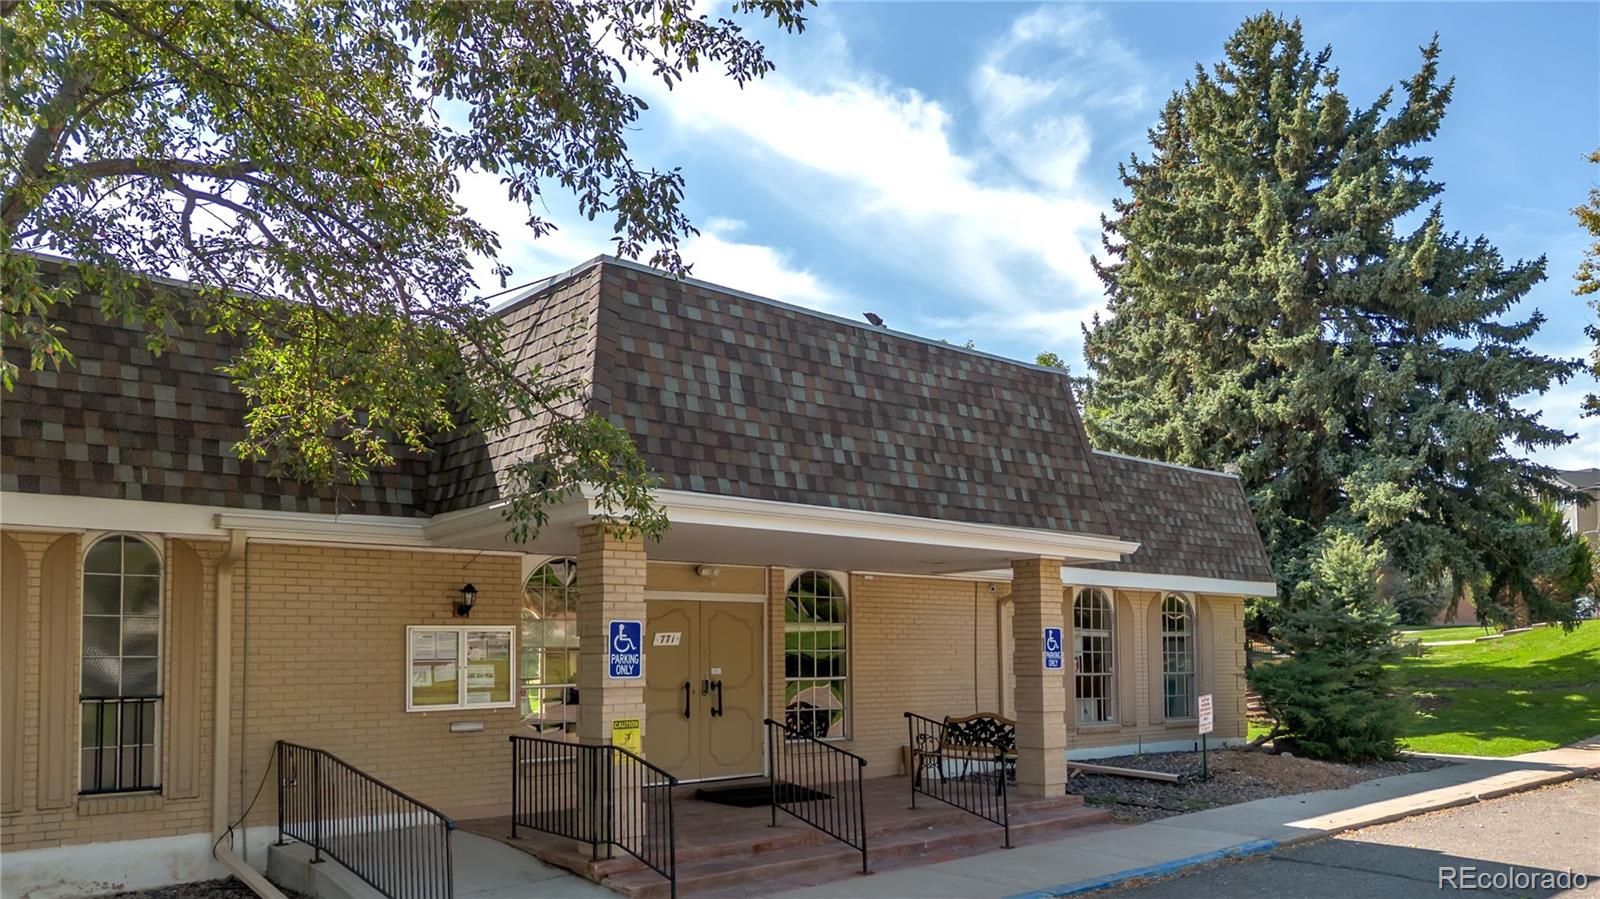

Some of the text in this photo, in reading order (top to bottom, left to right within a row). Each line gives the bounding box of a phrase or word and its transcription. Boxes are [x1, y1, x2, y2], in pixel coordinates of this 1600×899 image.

[611, 653, 639, 664] PARKING
[1045, 651, 1061, 659] PARKING
[1048, 659, 1059, 667] ONLY
[615, 664, 634, 675] ONLY
[613, 720, 639, 729] CAUTION
